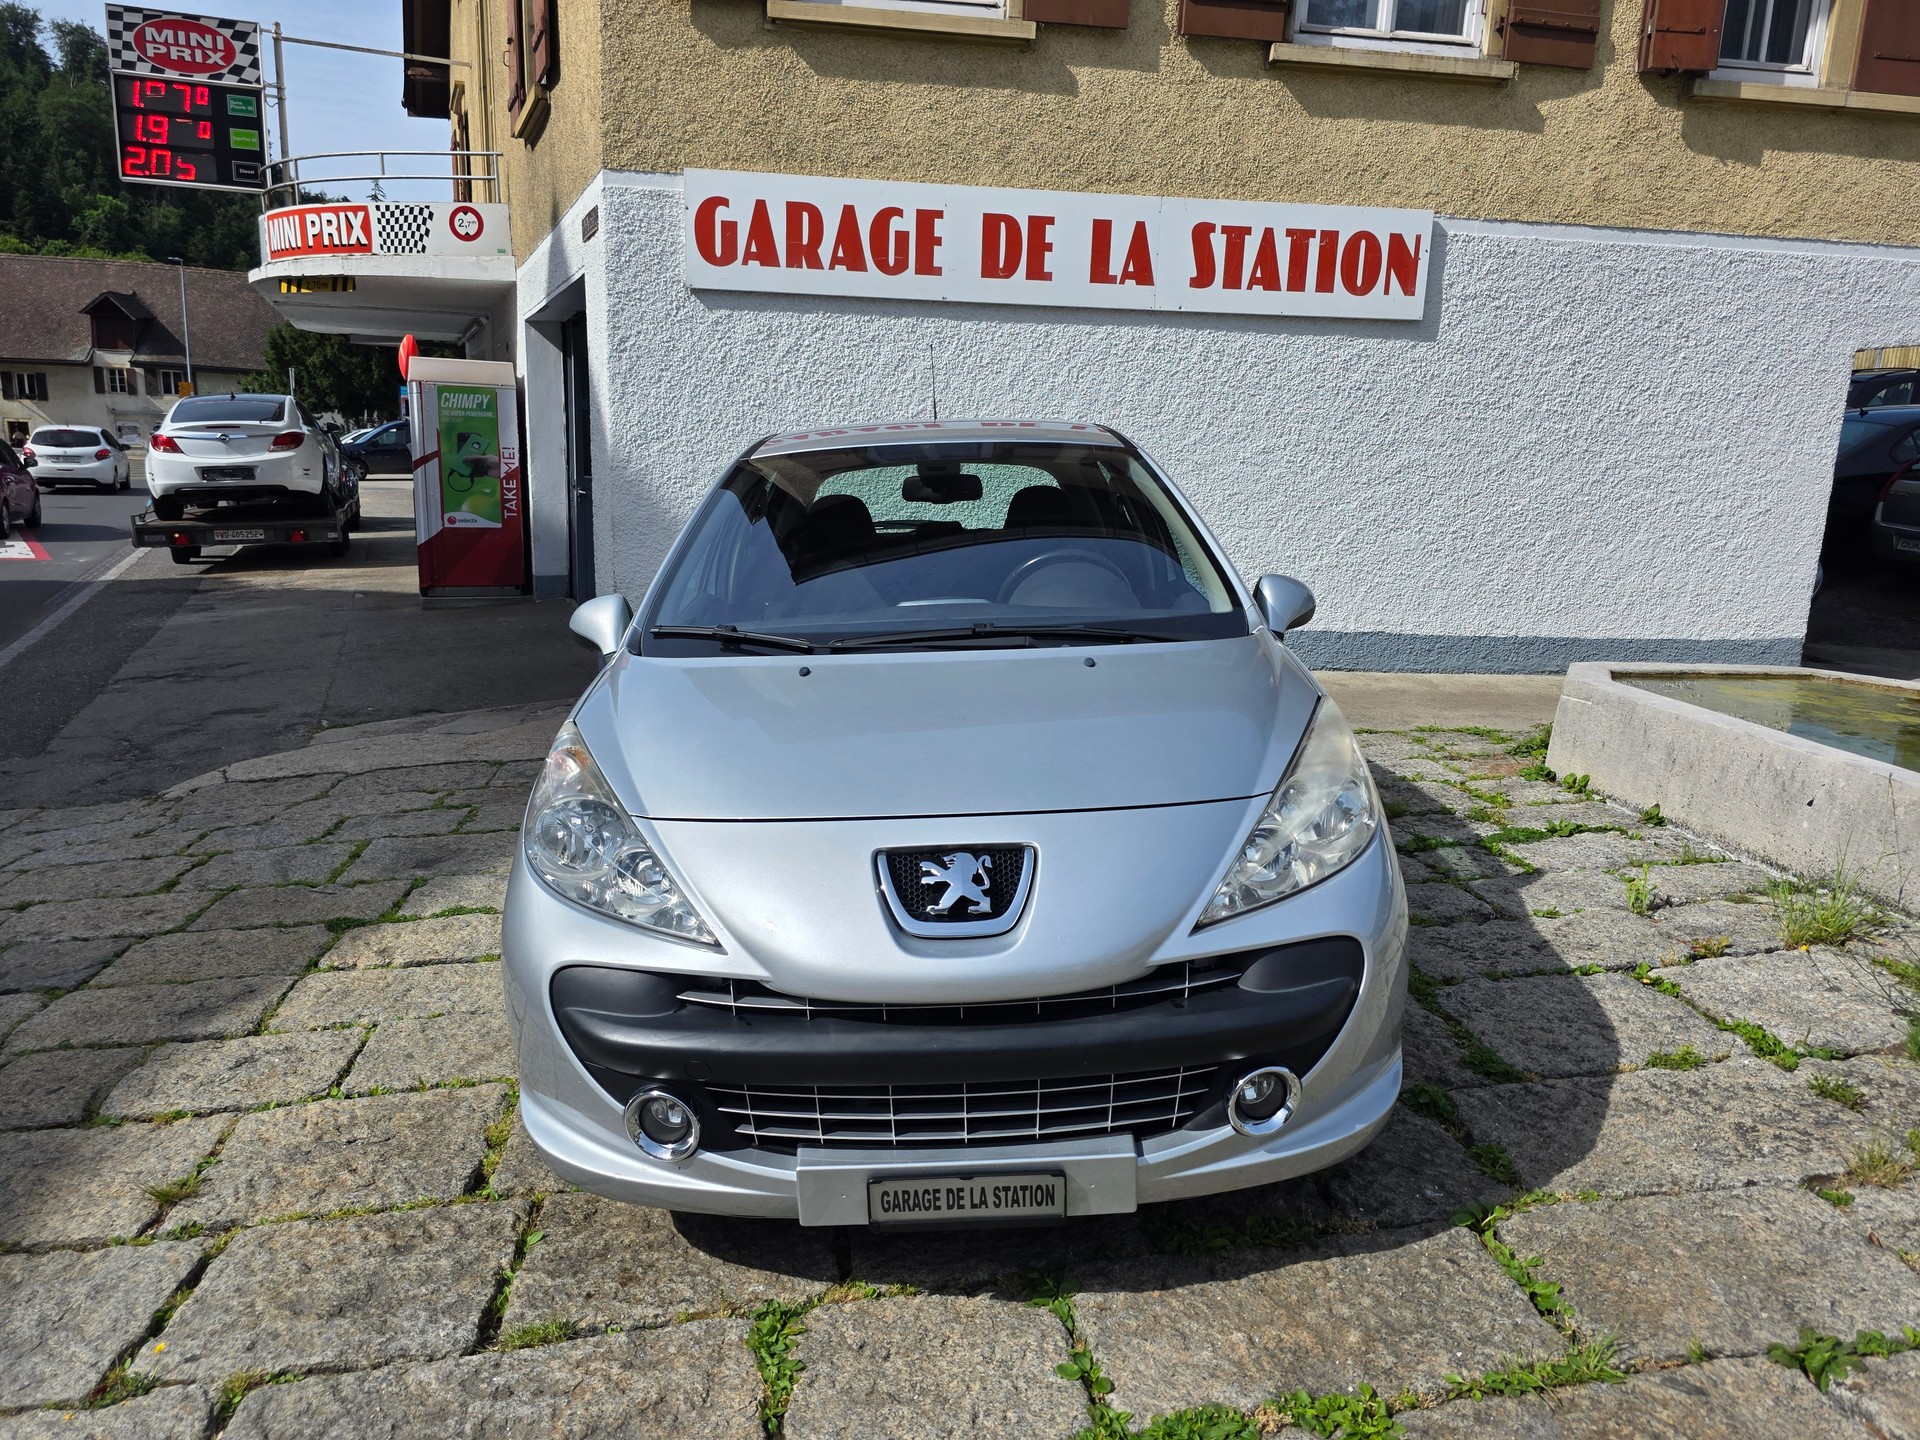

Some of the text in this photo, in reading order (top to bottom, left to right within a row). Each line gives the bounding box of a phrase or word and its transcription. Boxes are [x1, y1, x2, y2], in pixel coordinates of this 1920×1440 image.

[144, 26, 225, 50] MINI
[145, 43, 227, 66] PRIX
[268, 211, 369, 253] MINI PRIX
[694, 195, 1422, 297] GARAGE DE LA STATION
[440, 392, 491, 410] CHIMPY
[502, 447, 517, 519] TAKE ME!
[881, 1184, 1056, 1213] GARAGE DE LA STATION
